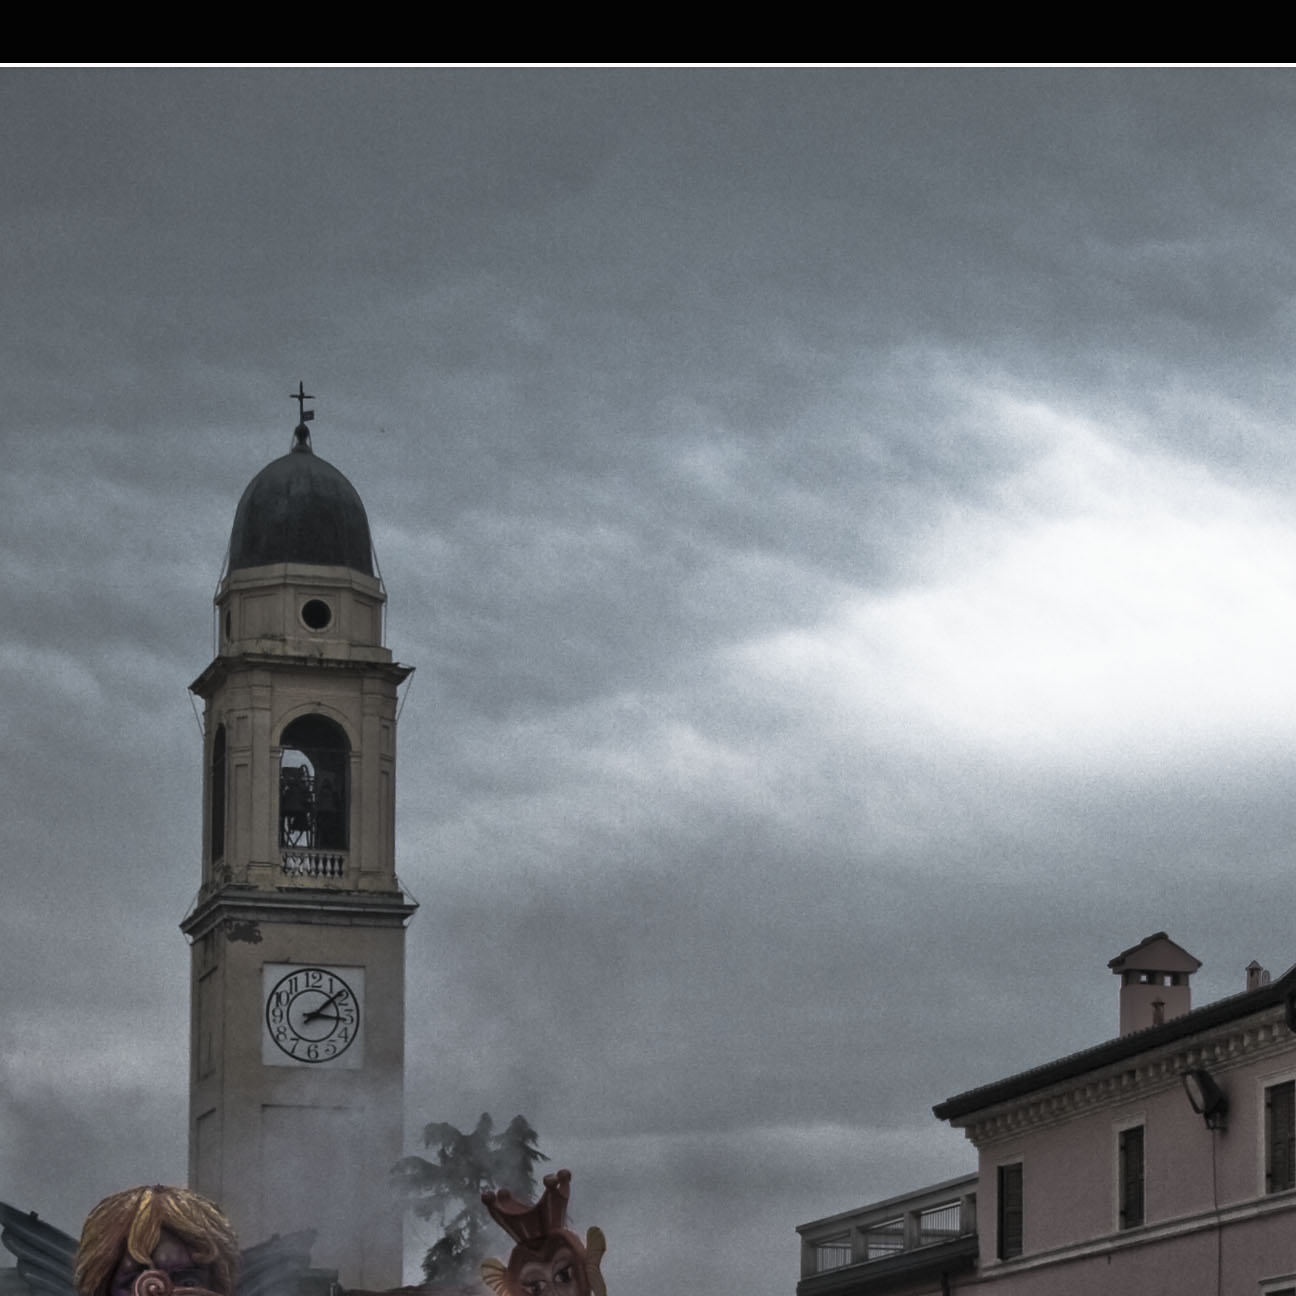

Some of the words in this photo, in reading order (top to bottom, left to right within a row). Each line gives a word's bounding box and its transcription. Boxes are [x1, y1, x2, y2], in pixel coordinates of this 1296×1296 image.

[289, 976, 298, 995] 11
[305, 972, 322, 988] 12
[328, 978, 333, 994] 1
[274, 990, 290, 1008] 10
[338, 989, 349, 1006] 2
[271, 1007, 283, 1024] 9
[343, 1009, 354, 1025] 3
[276, 1025, 287, 1041] 8
[337, 1027, 349, 1042] 4
[290, 1038, 300, 1054] 7
[307, 1044, 319, 1060] 6
[325, 1039, 337, 1055] 5
